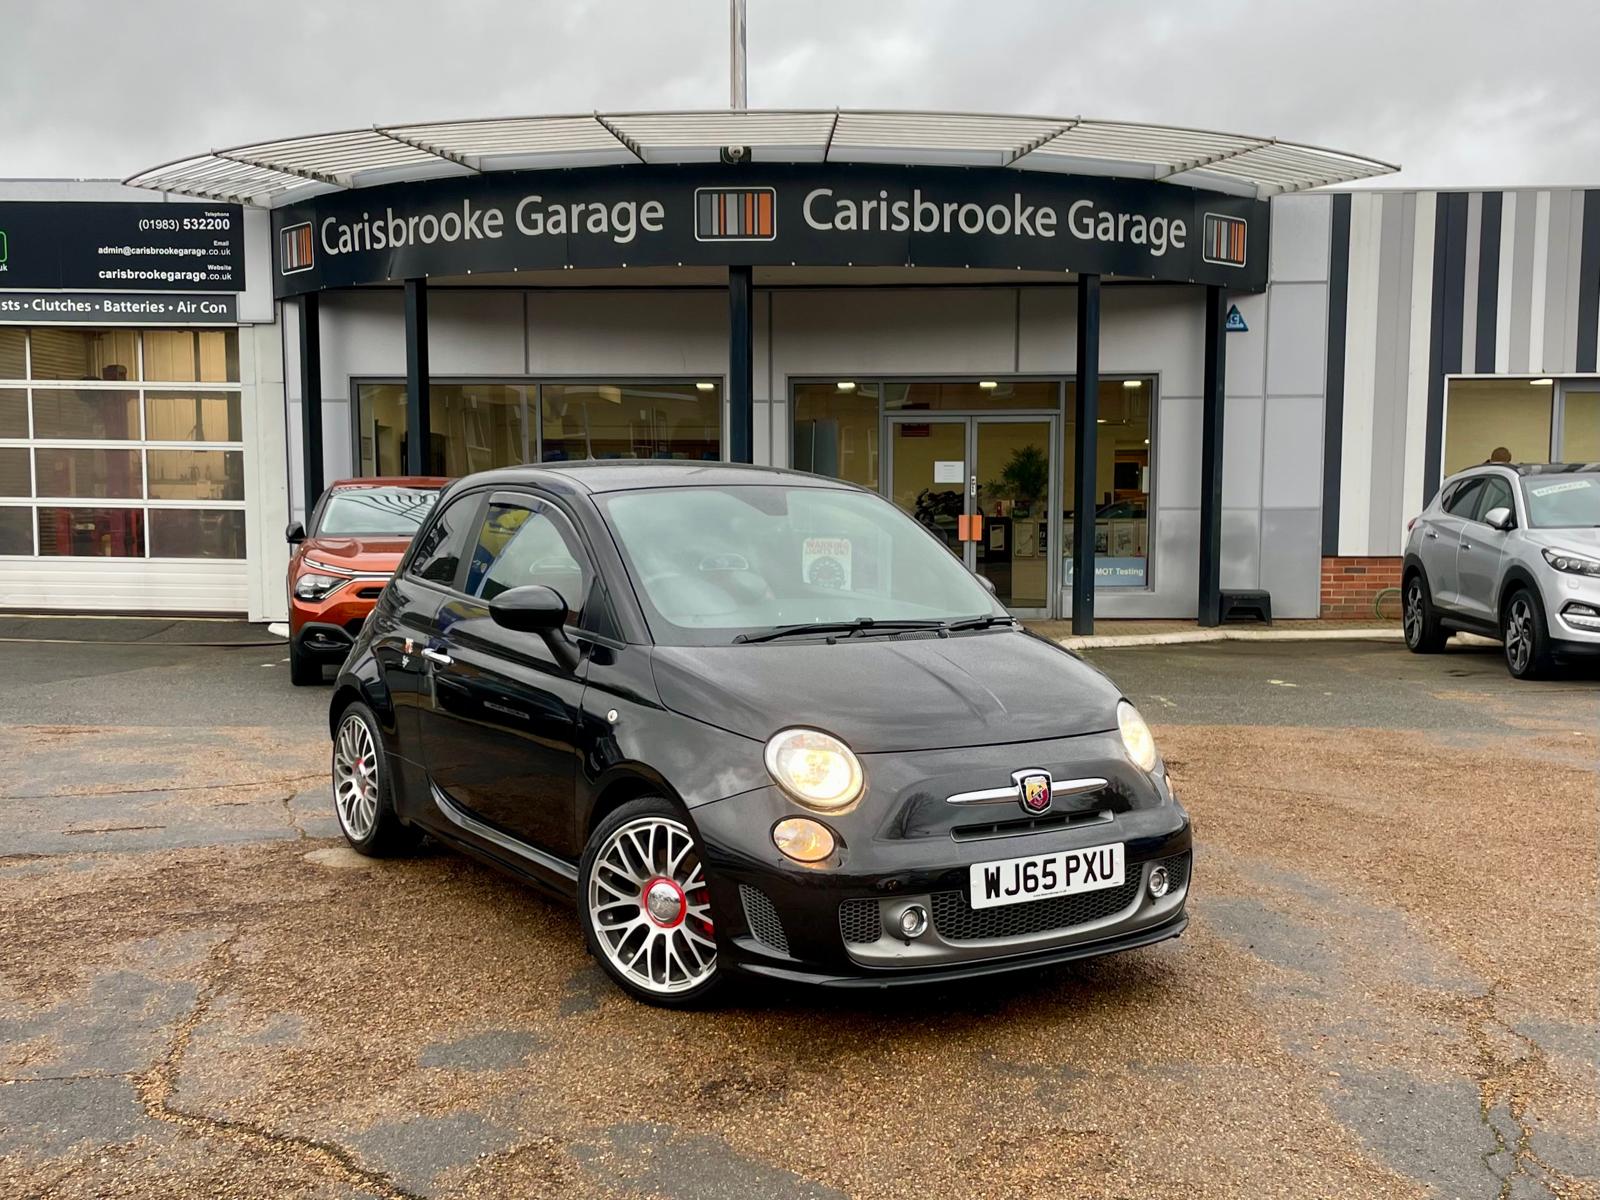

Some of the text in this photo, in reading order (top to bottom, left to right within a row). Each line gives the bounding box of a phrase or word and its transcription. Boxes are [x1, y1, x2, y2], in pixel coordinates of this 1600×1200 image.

[138, 218, 230, 231] (01983) 532200
[321, 195, 665, 255] Carisbrooke Garage
[802, 188, 1187, 257] Carisbrooke Garage
[98, 246, 232, 257] admin@carisbrookegarage.co.uk
[98, 269, 232, 282] carisbrookegarage.co.uk
[1, 298, 227, 314] sts Clutches Batteries Air Con
[1095, 567, 1144, 577] MOT Testing
[984, 848, 1115, 900] WJ65 PXU
